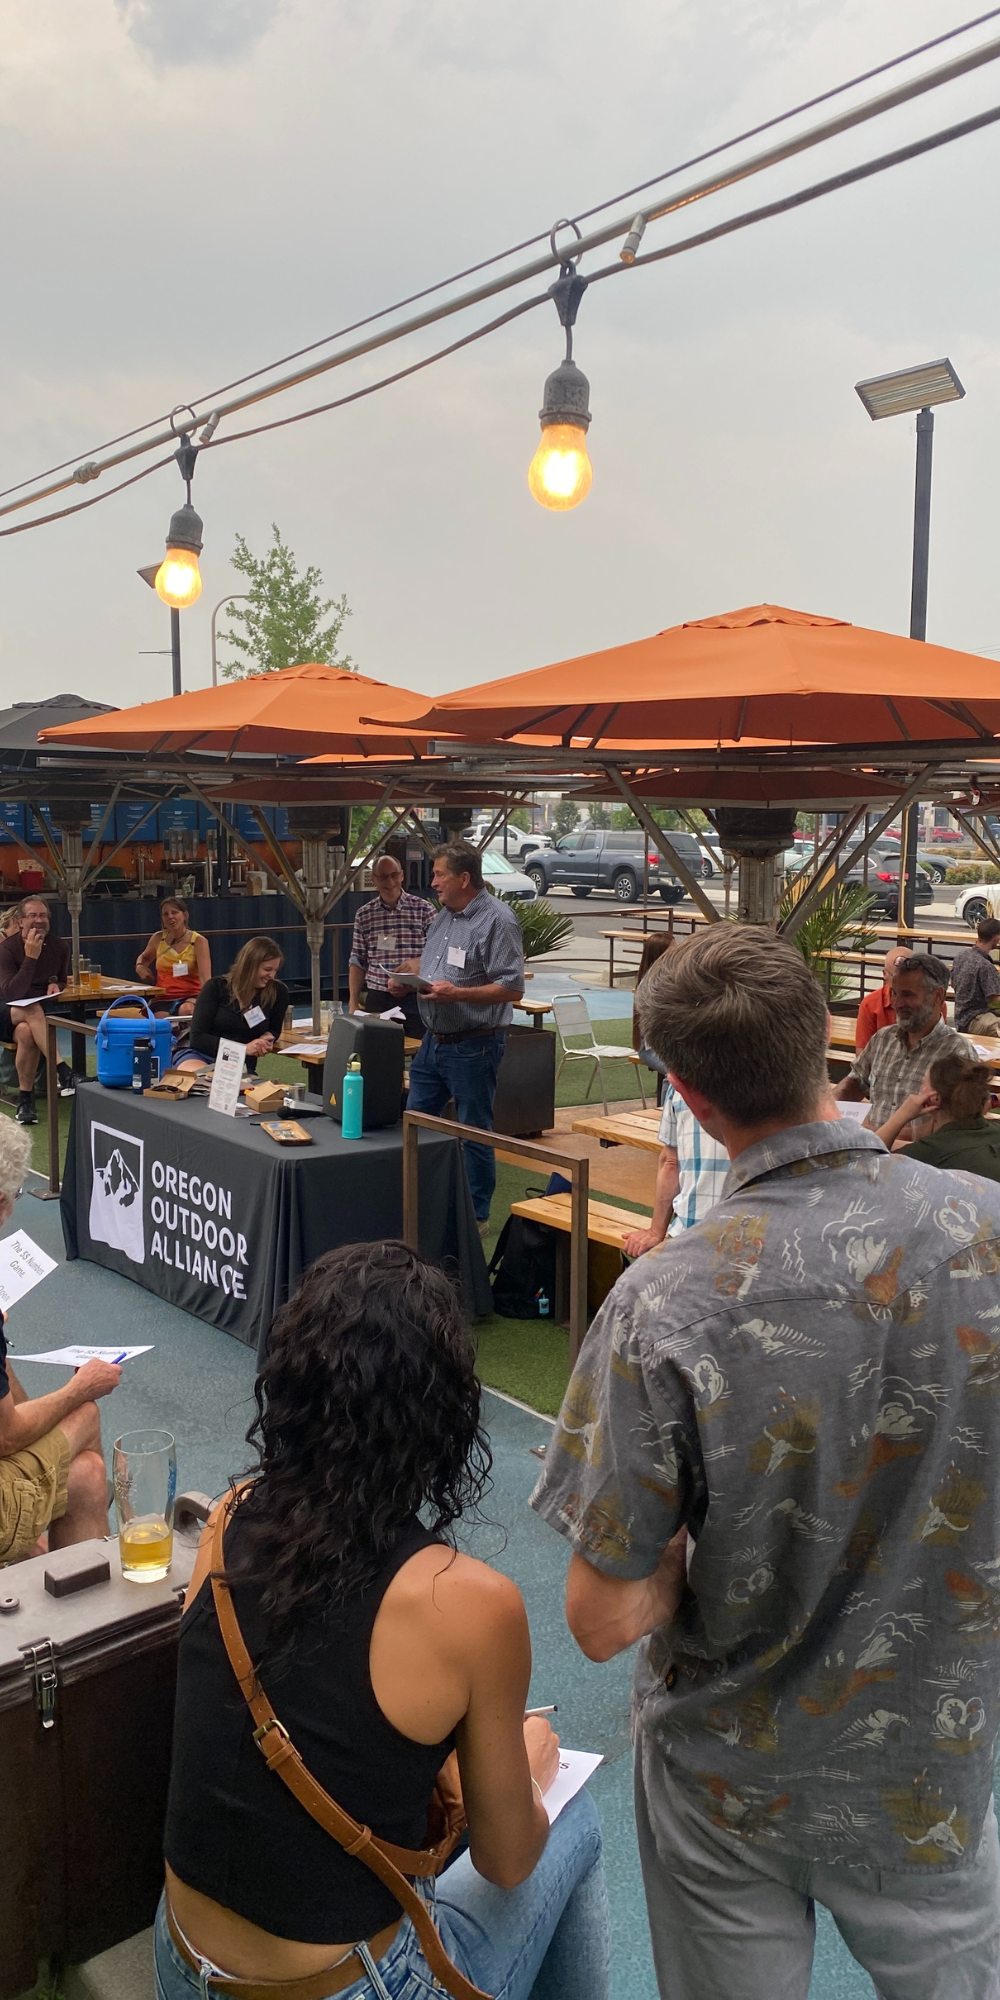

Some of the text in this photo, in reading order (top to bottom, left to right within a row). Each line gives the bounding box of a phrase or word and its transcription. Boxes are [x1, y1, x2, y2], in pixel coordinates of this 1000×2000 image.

[151, 1160, 232, 1220] OREGON
[11, 1240, 22, 1254] The
[19, 1250, 31, 1261] 5S
[151, 1195, 249, 1266] OUTDOOR
[150, 1230, 247, 1300] ALLIANCE
